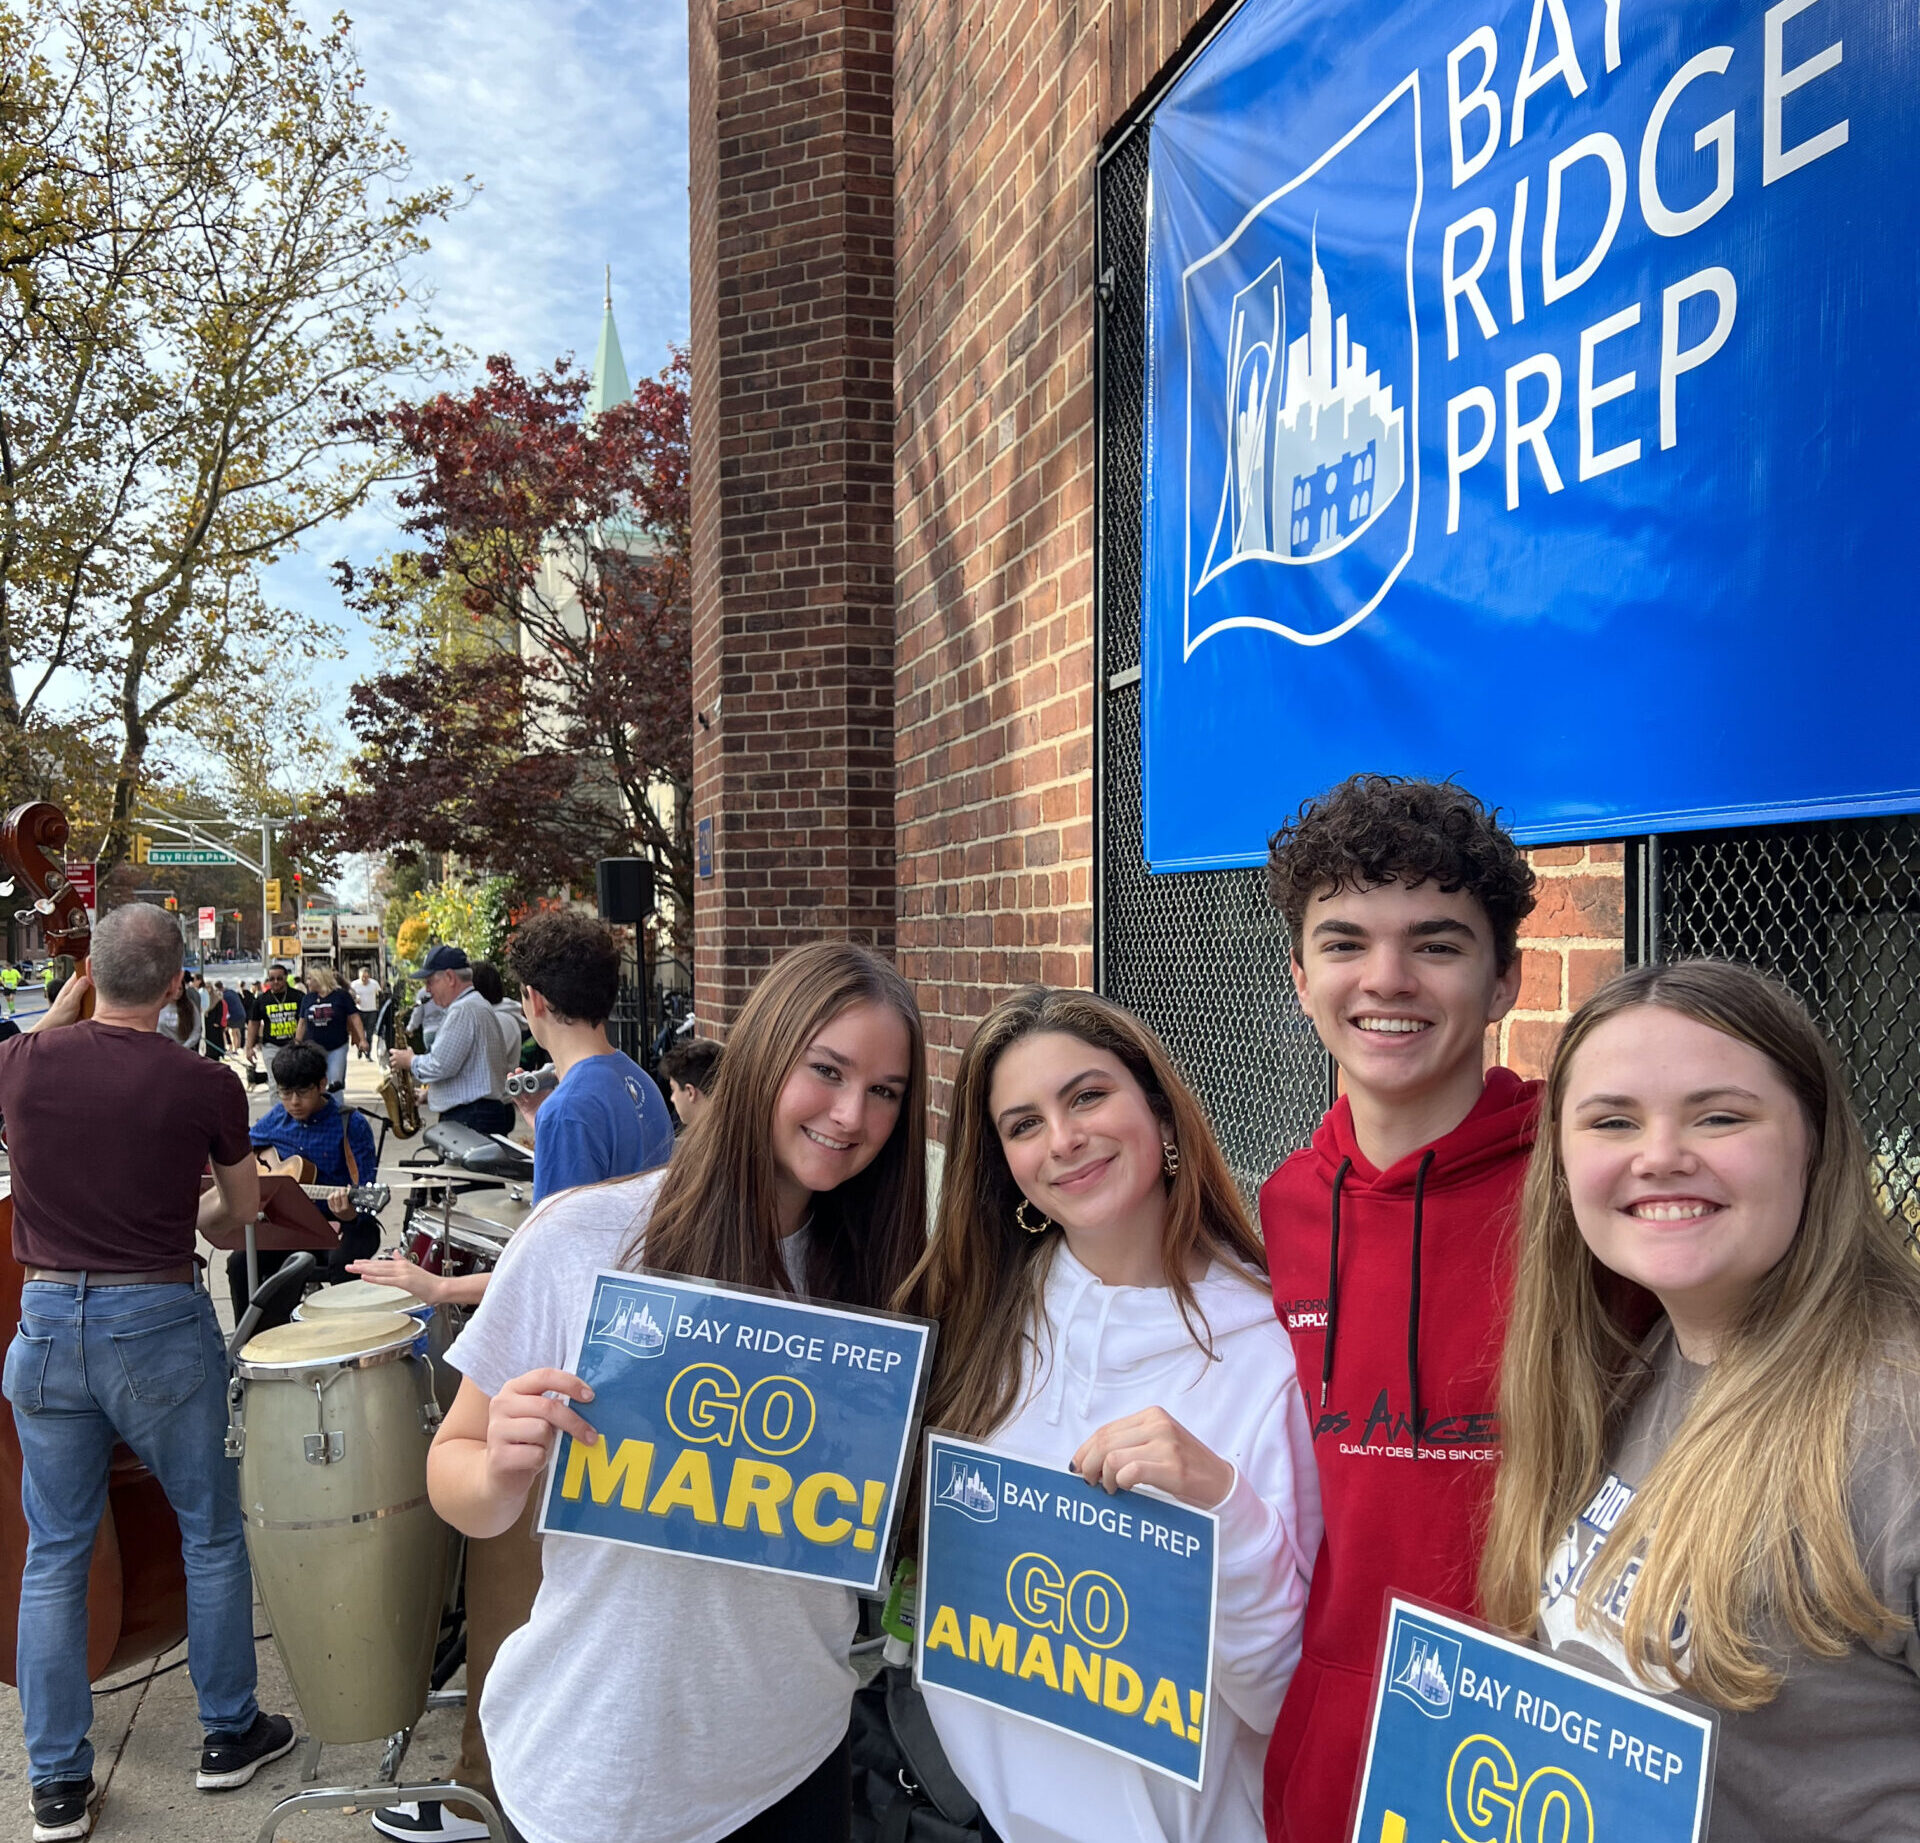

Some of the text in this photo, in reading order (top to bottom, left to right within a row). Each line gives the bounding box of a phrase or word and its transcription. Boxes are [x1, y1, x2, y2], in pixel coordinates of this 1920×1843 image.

[1442, 0, 1849, 361] RIDGE
[1446, 266, 1738, 535] PREP
[152, 853, 233, 863] Bay Ridge Pkwy
[674, 1315, 902, 1374] BAY RIDGE PREP
[1288, 1312, 1328, 1328] SUPPLY.
[665, 1362, 816, 1456] GO
[1339, 1443, 1383, 1457] QUALITY
[1386, 1446, 1446, 1460] DESGNS
[1448, 1449, 1493, 1461] SINCE
[561, 1434, 887, 1552] MARC!
[1003, 1482, 1200, 1558] BAY RIDGE PREP
[1006, 1552, 1129, 1649] GO
[926, 1604, 1204, 1744] AMANDA!
[1459, 1667, 1682, 1784] BAY RIDGE PREP
[1447, 1733, 1594, 1843] GO
